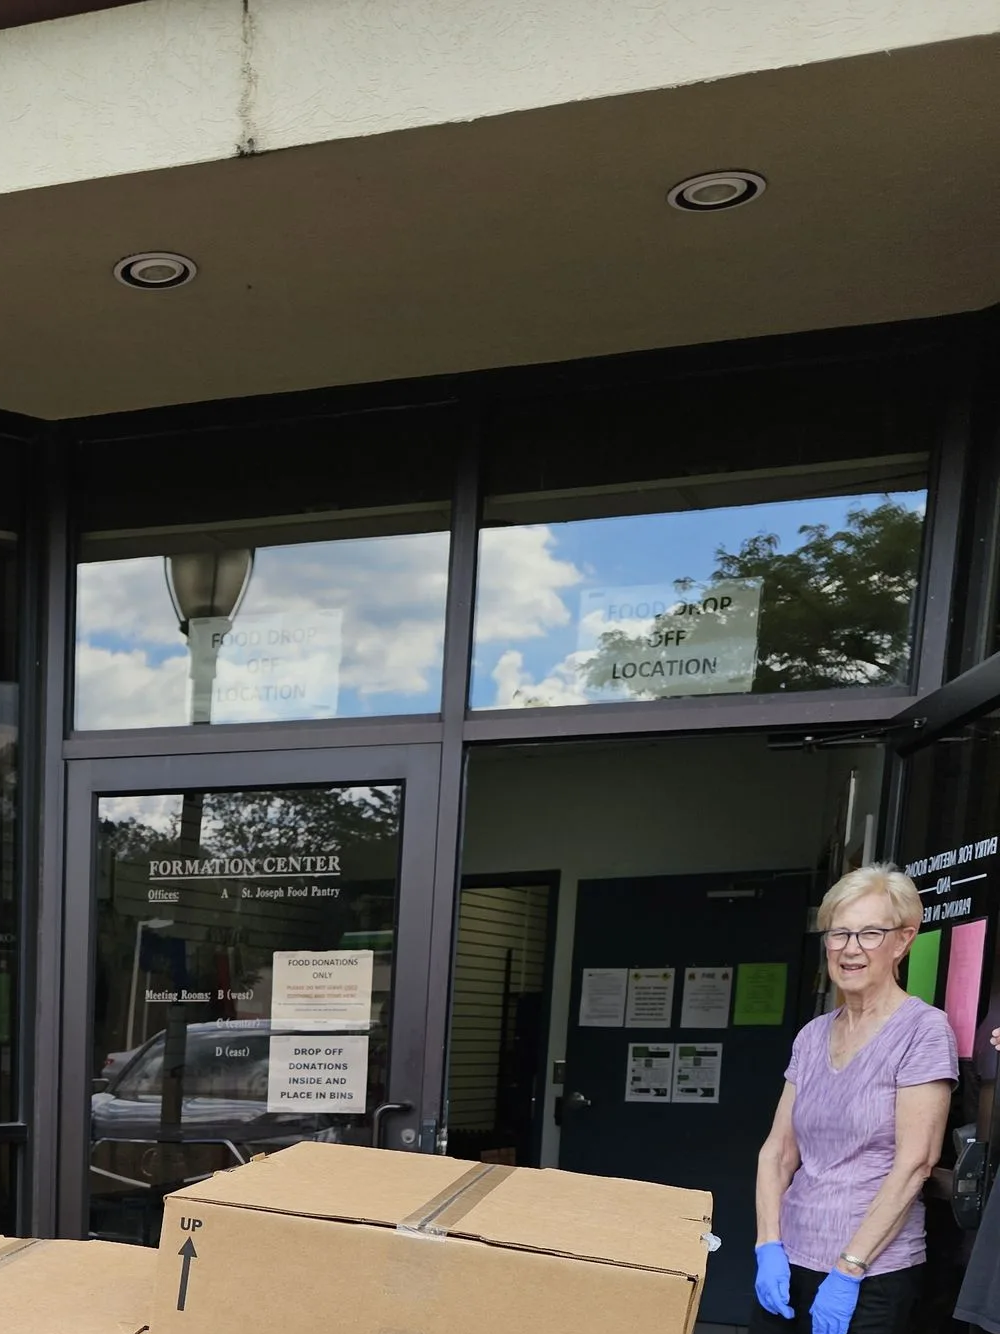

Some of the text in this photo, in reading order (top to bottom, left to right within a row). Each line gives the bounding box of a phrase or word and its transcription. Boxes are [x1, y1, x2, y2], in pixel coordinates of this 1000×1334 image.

[608, 596, 733, 621] FOOD DROP
[211, 628, 317, 648] FOOD DROP
[648, 630, 687, 648] OFF
[246, 658, 280, 674] OFF
[612, 657, 717, 680] LOCATION
[217, 684, 306, 703] LOCATION
[150, 855, 341, 876] FORMATION CENTER
[148, 885, 341, 900] Offices: A St. Joseph Food Pantry
[288, 958, 358, 967] FOOD DONATIONS
[145, 989, 254, 1000] Meeting Rooms: B (west)
[216, 1046, 250, 1057] D (east)
[180, 1216, 203, 1232] UP
